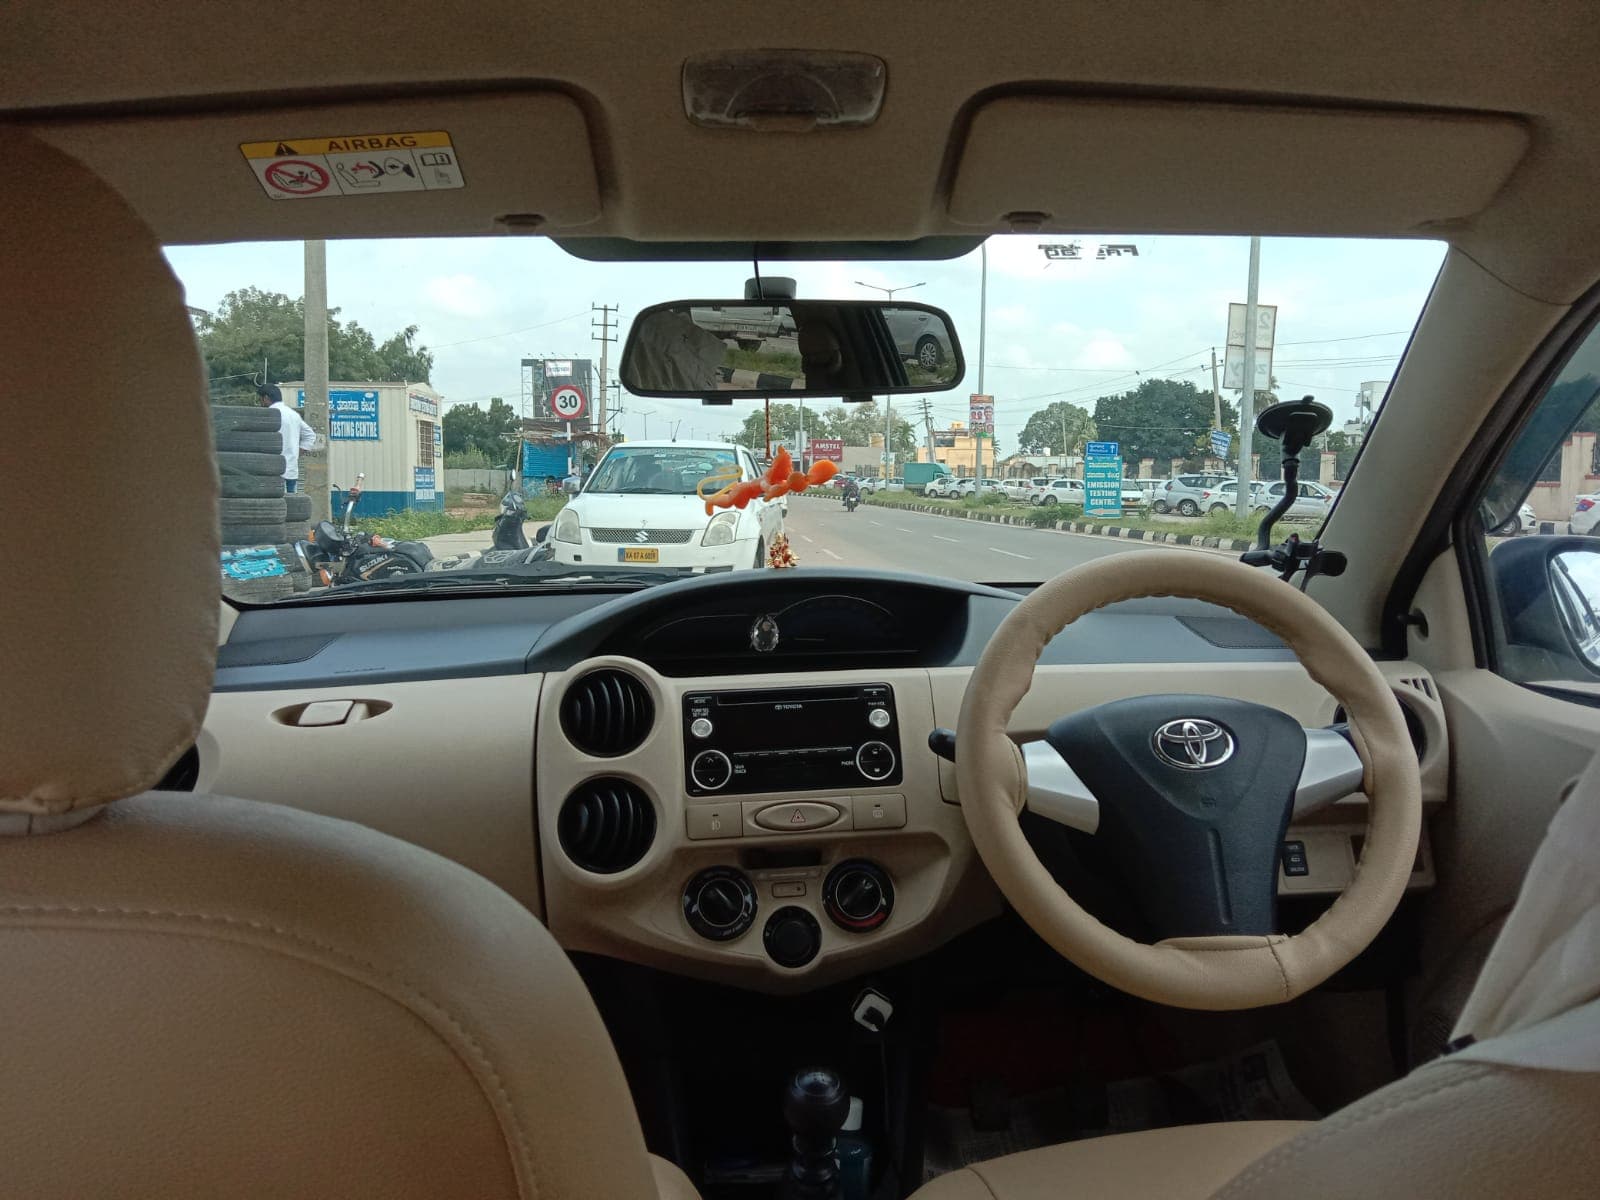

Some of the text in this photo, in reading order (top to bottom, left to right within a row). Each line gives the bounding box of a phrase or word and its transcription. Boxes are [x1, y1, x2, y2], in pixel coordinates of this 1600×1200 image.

[328, 136, 417, 152] AIRBAG
[559, 394, 578, 409] 30
[331, 421, 377, 438] TESTING CENTRE
[815, 442, 841, 450] AMSTEL
[1087, 481, 1120, 489] EMISSION
[1090, 498, 1116, 506] CENTRE
[359, 554, 388, 573] SUZUKI
